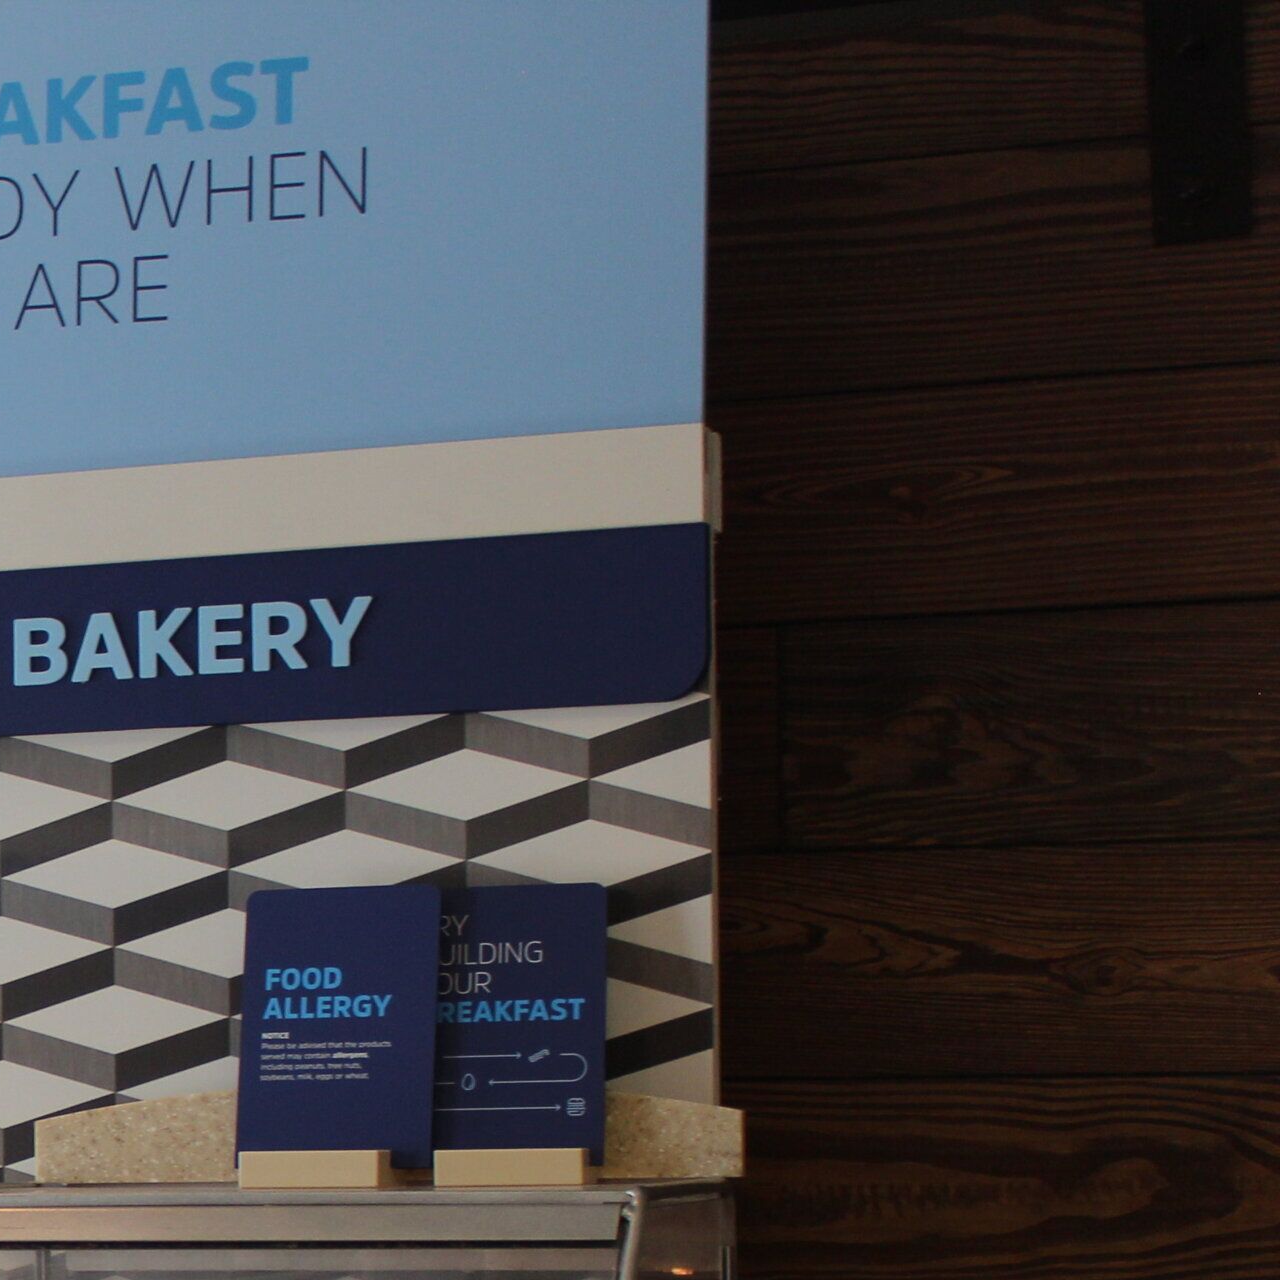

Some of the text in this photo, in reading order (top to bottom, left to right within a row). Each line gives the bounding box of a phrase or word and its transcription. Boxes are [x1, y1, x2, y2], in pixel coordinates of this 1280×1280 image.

[114, 146, 369, 233] WHEN
[14, 254, 170, 330] ARE
[12, 596, 372, 688] BAKERY
[439, 914, 470, 936] RY
[439, 940, 544, 966] UILDING
[265, 966, 343, 991] FOOD
[438, 971, 492, 995] OUR
[262, 994, 393, 1020] ALLERGY
[438, 998, 586, 1023] REAKFAST
